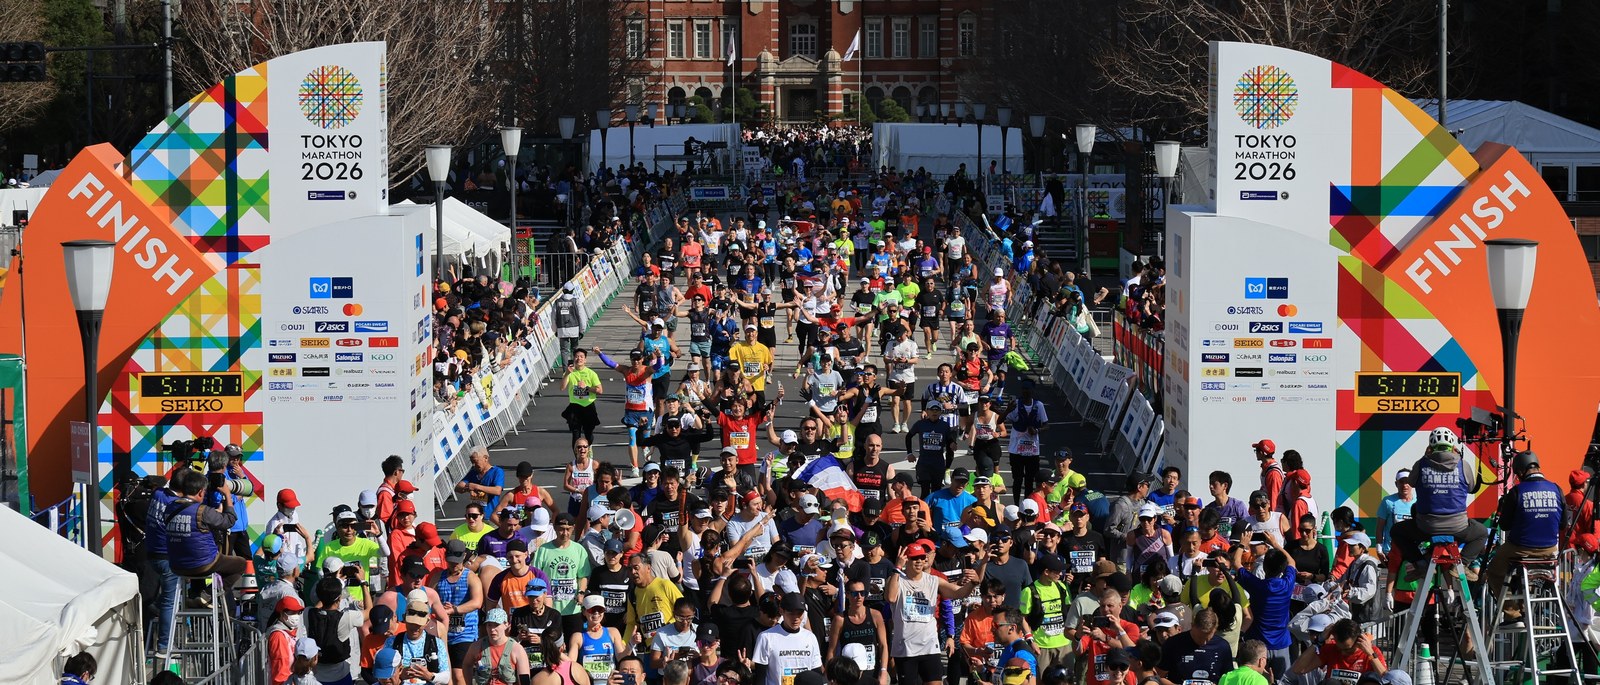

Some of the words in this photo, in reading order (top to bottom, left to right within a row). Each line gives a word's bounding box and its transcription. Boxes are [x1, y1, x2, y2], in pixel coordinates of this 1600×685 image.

[301, 135, 362, 148] TOKYO
[1234, 135, 1296, 148] TOKYO
[302, 151, 361, 159] MARATHON
[1235, 151, 1295, 159] MARATHON
[302, 162, 363, 180] 2026
[1234, 162, 1296, 180] 2026
[67, 171, 194, 296] FINISH
[1405, 169, 1532, 295] FINISH
[302, 306, 328, 314] STARTS
[1237, 306, 1263, 314] STARTS
[162, 376, 240, 395] 5:11:01
[1378, 376, 1456, 395] 5:11:01
[161, 399, 223, 412] SEIKO
[1377, 399, 1440, 412] SEIKO
[1421, 475, 1460, 483] CAMERA
[1522, 490, 1557, 500] SPONSOR
[1523, 499, 1558, 508] CAMERA
